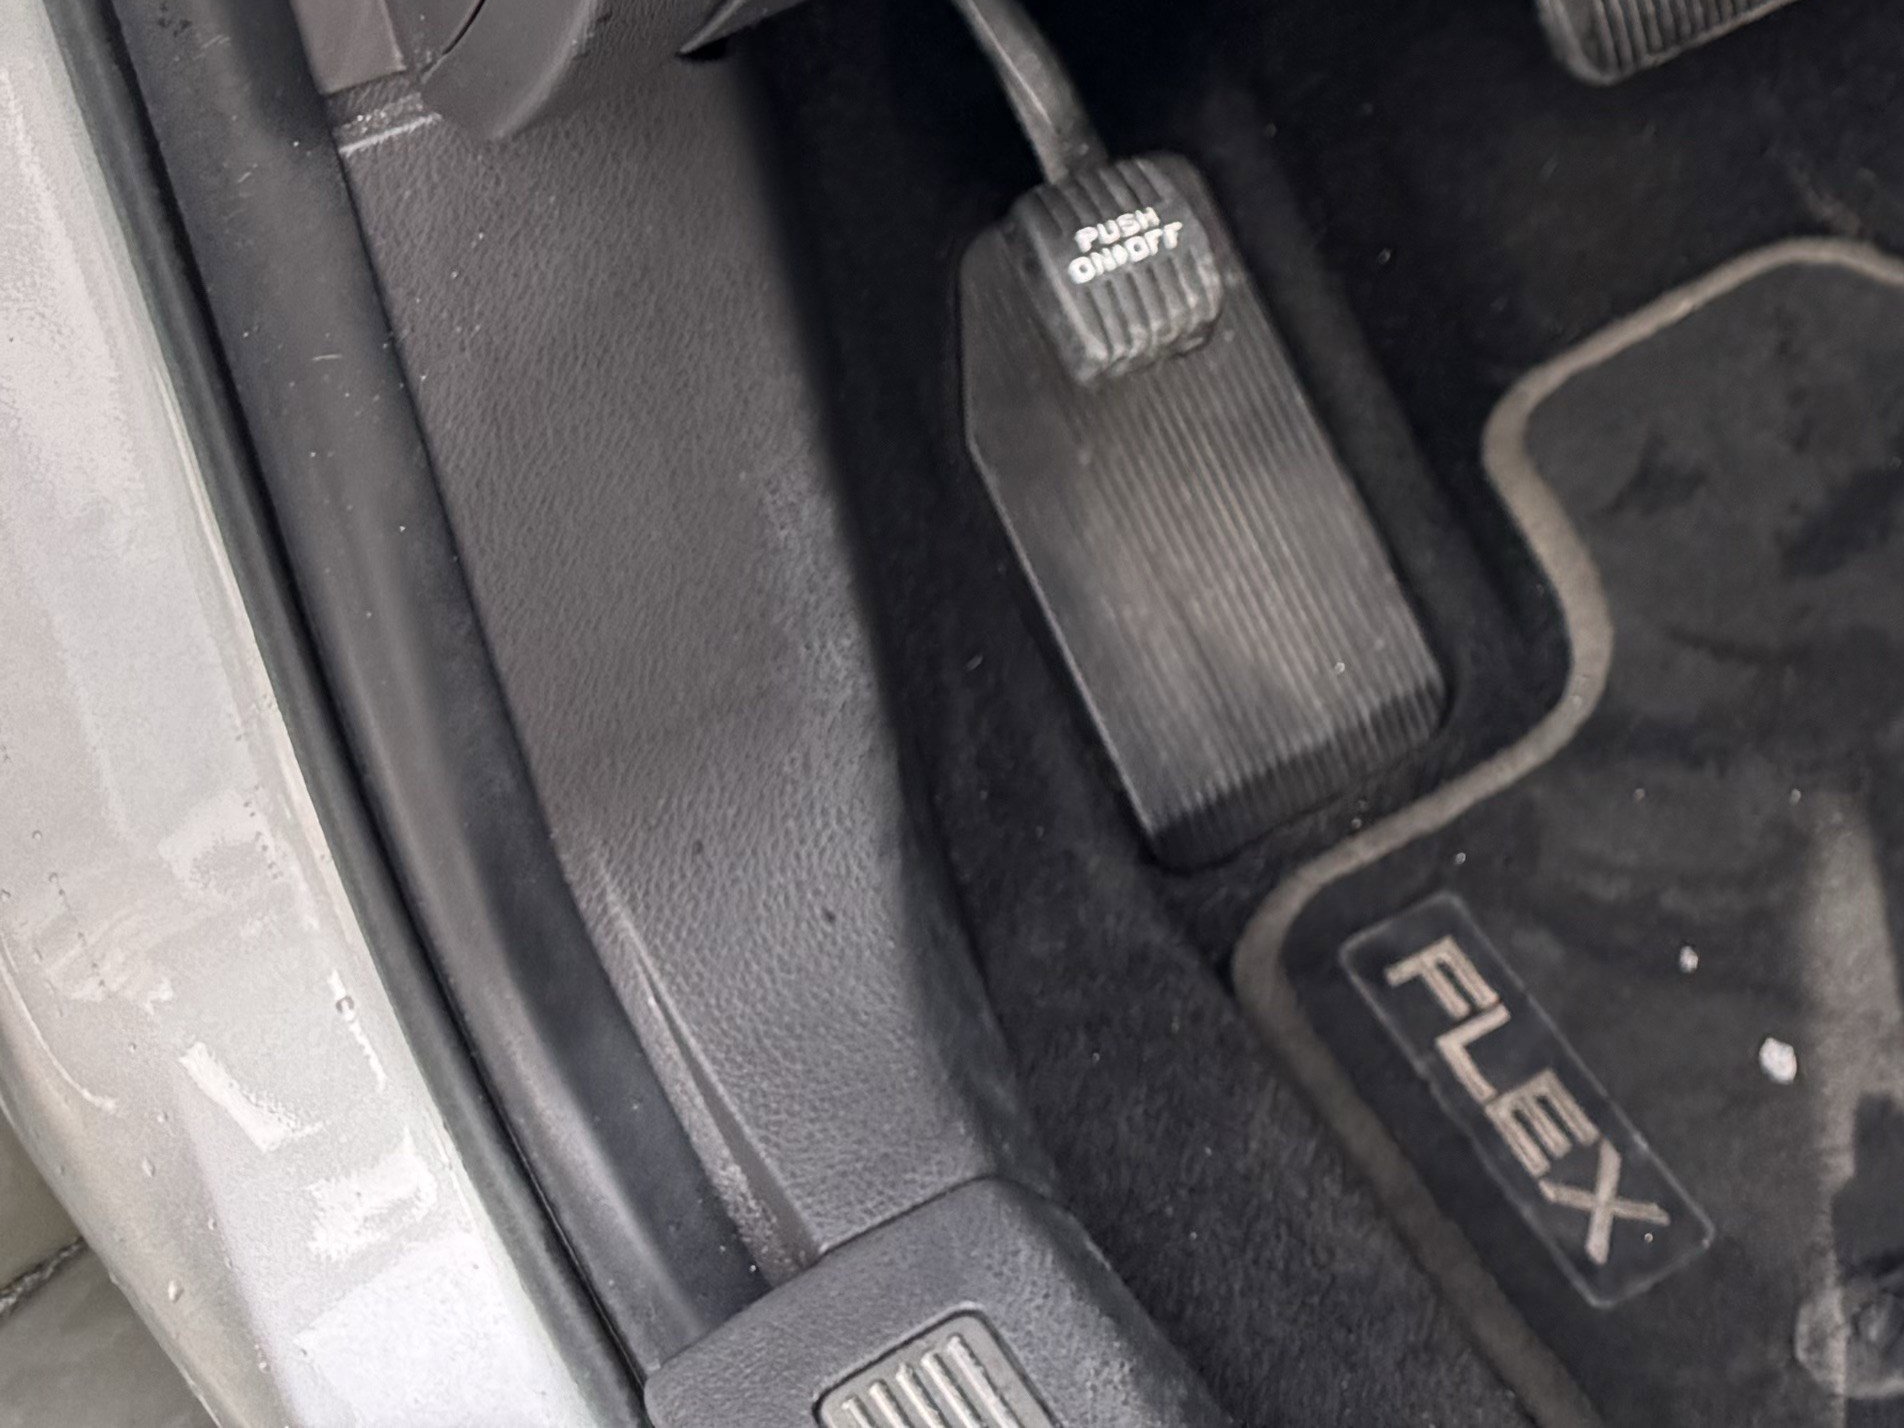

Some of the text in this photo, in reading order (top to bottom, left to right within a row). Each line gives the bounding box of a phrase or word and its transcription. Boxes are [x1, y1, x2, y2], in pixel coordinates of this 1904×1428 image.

[1068, 221, 1182, 284] ON/OFF
[1074, 206, 1160, 253] PUSH
[1385, 936, 1670, 1265] FLEX
